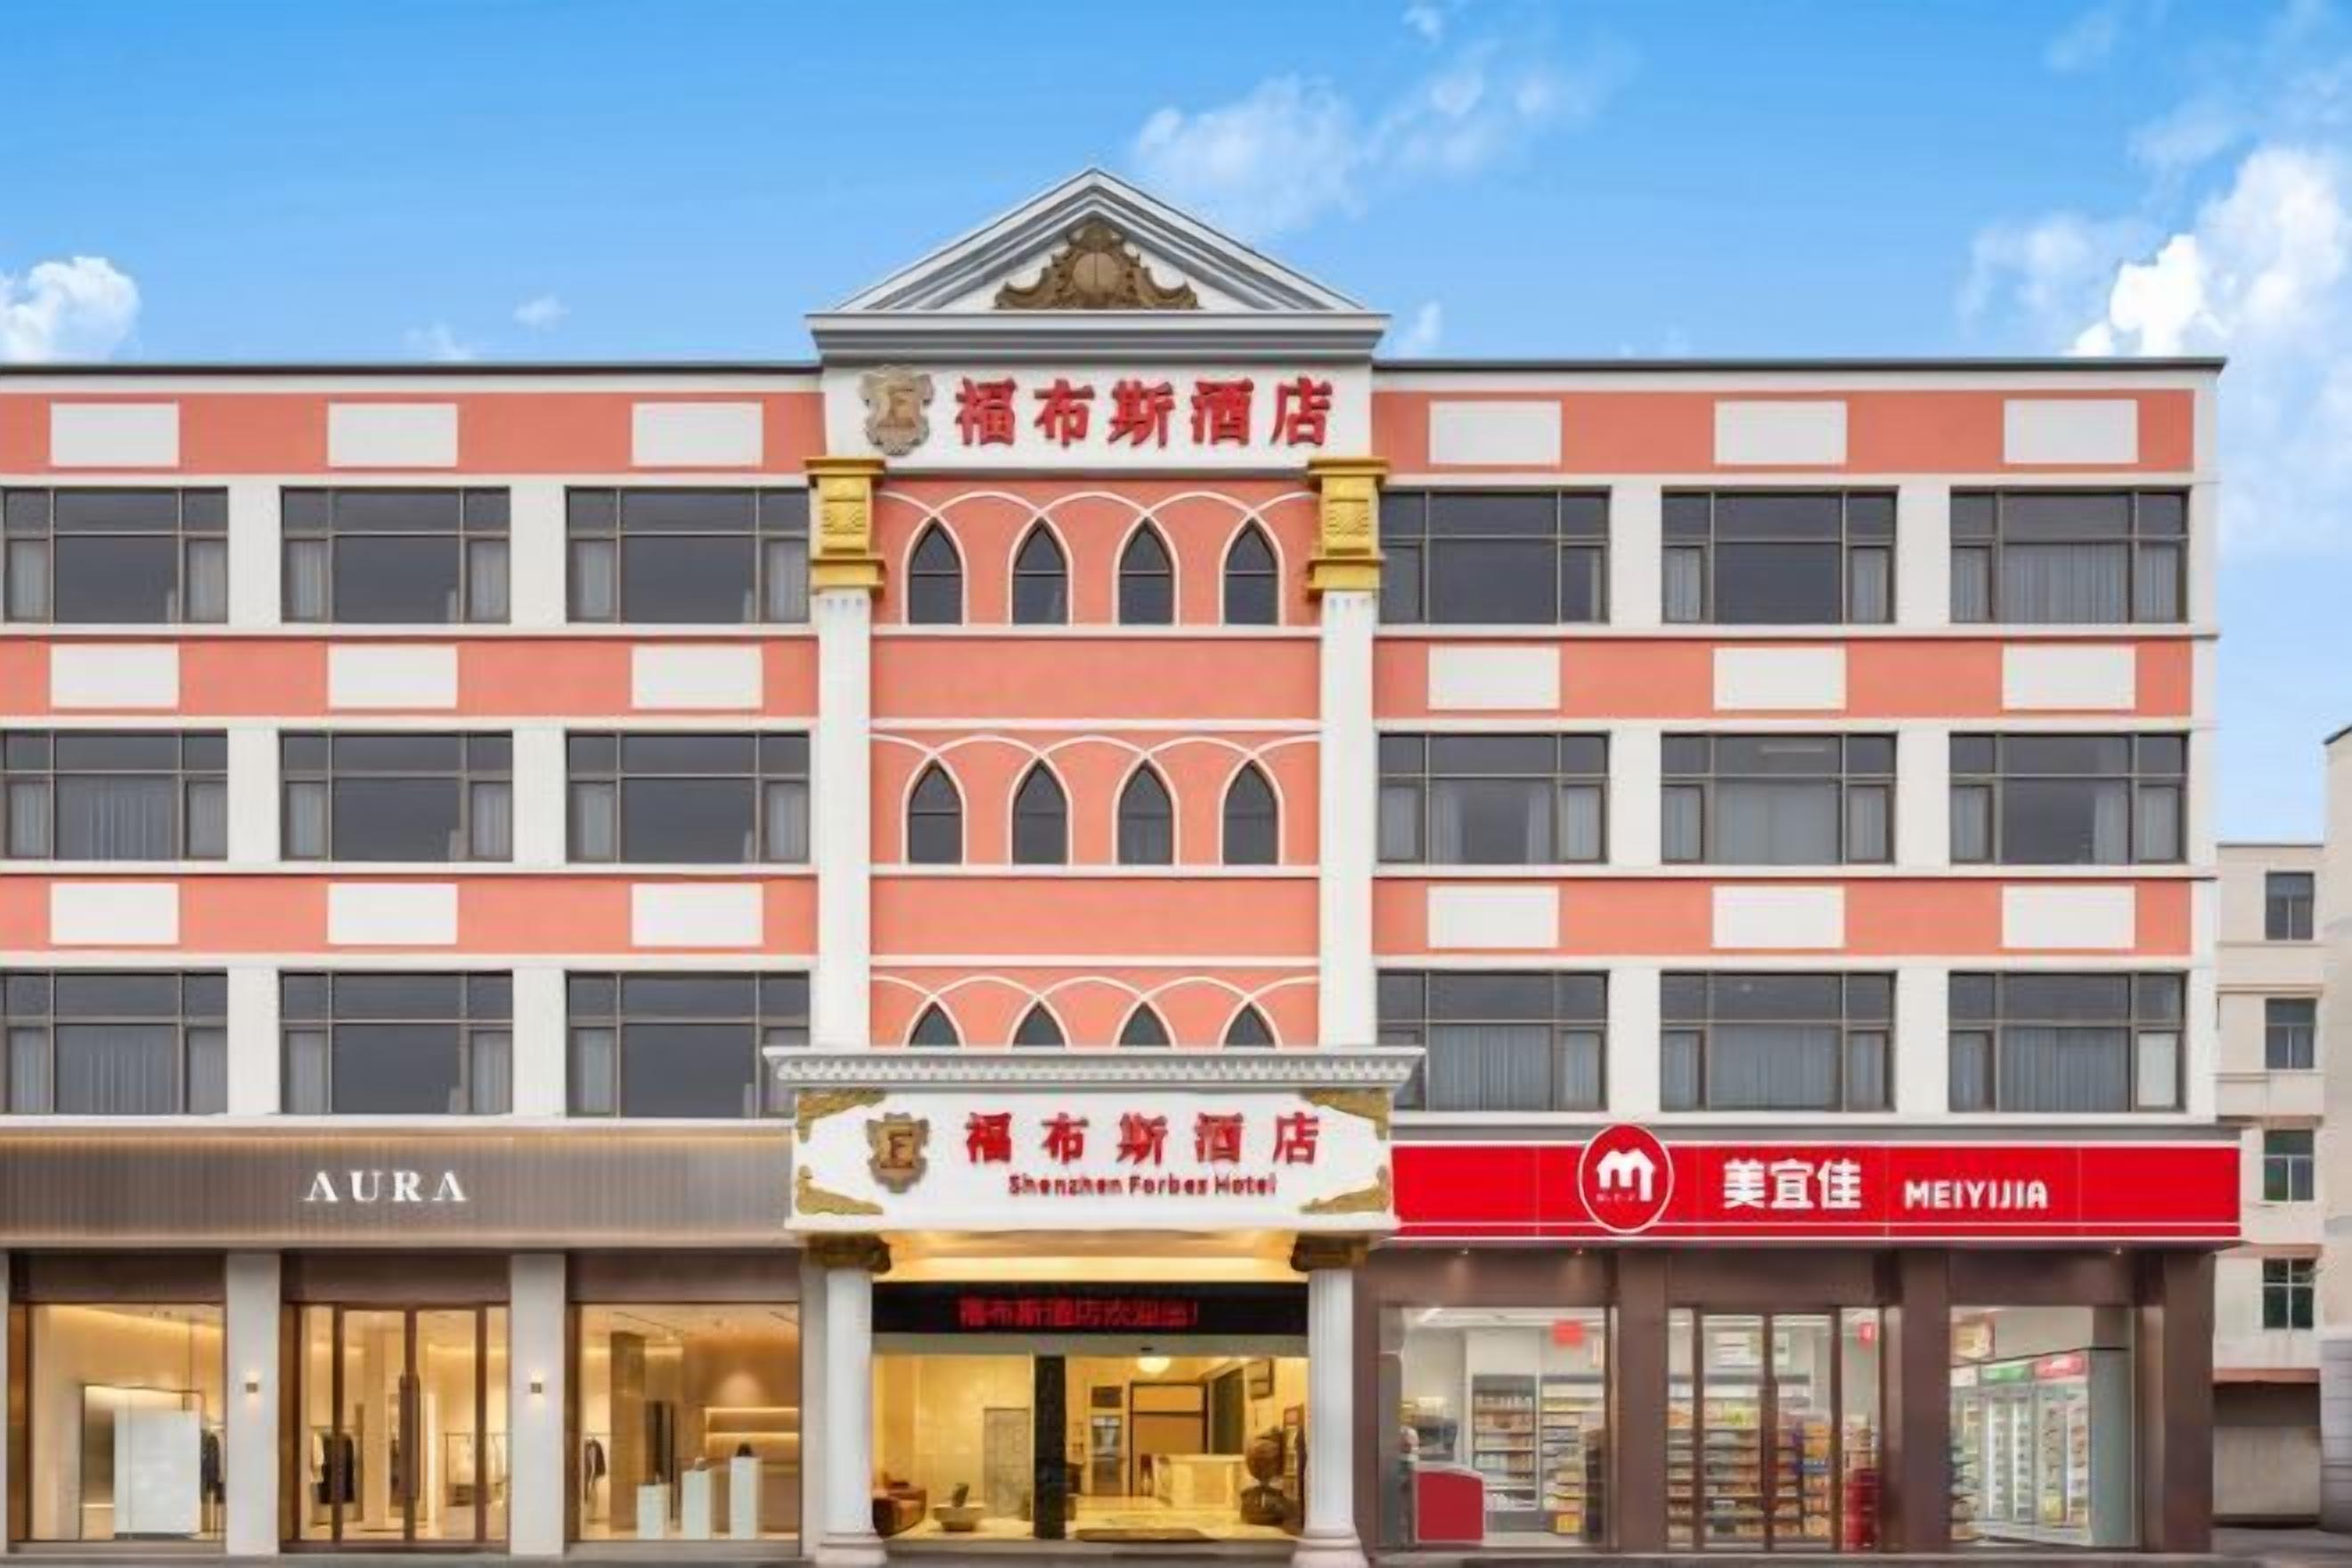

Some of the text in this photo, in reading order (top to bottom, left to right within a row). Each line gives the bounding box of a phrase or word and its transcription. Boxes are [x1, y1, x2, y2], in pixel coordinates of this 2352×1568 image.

[955, 378, 1332, 447] 福布斯酒店
[966, 1112, 1320, 1165] 福布斯酒店
[301, 1170, 469, 1203] AURA
[1008, 1173, 1278, 1196] Shenzhen Forbes Hotel
[1723, 1159, 1861, 1210] 美宜佳
[1904, 1180, 2048, 1210] MEIYIJIA
